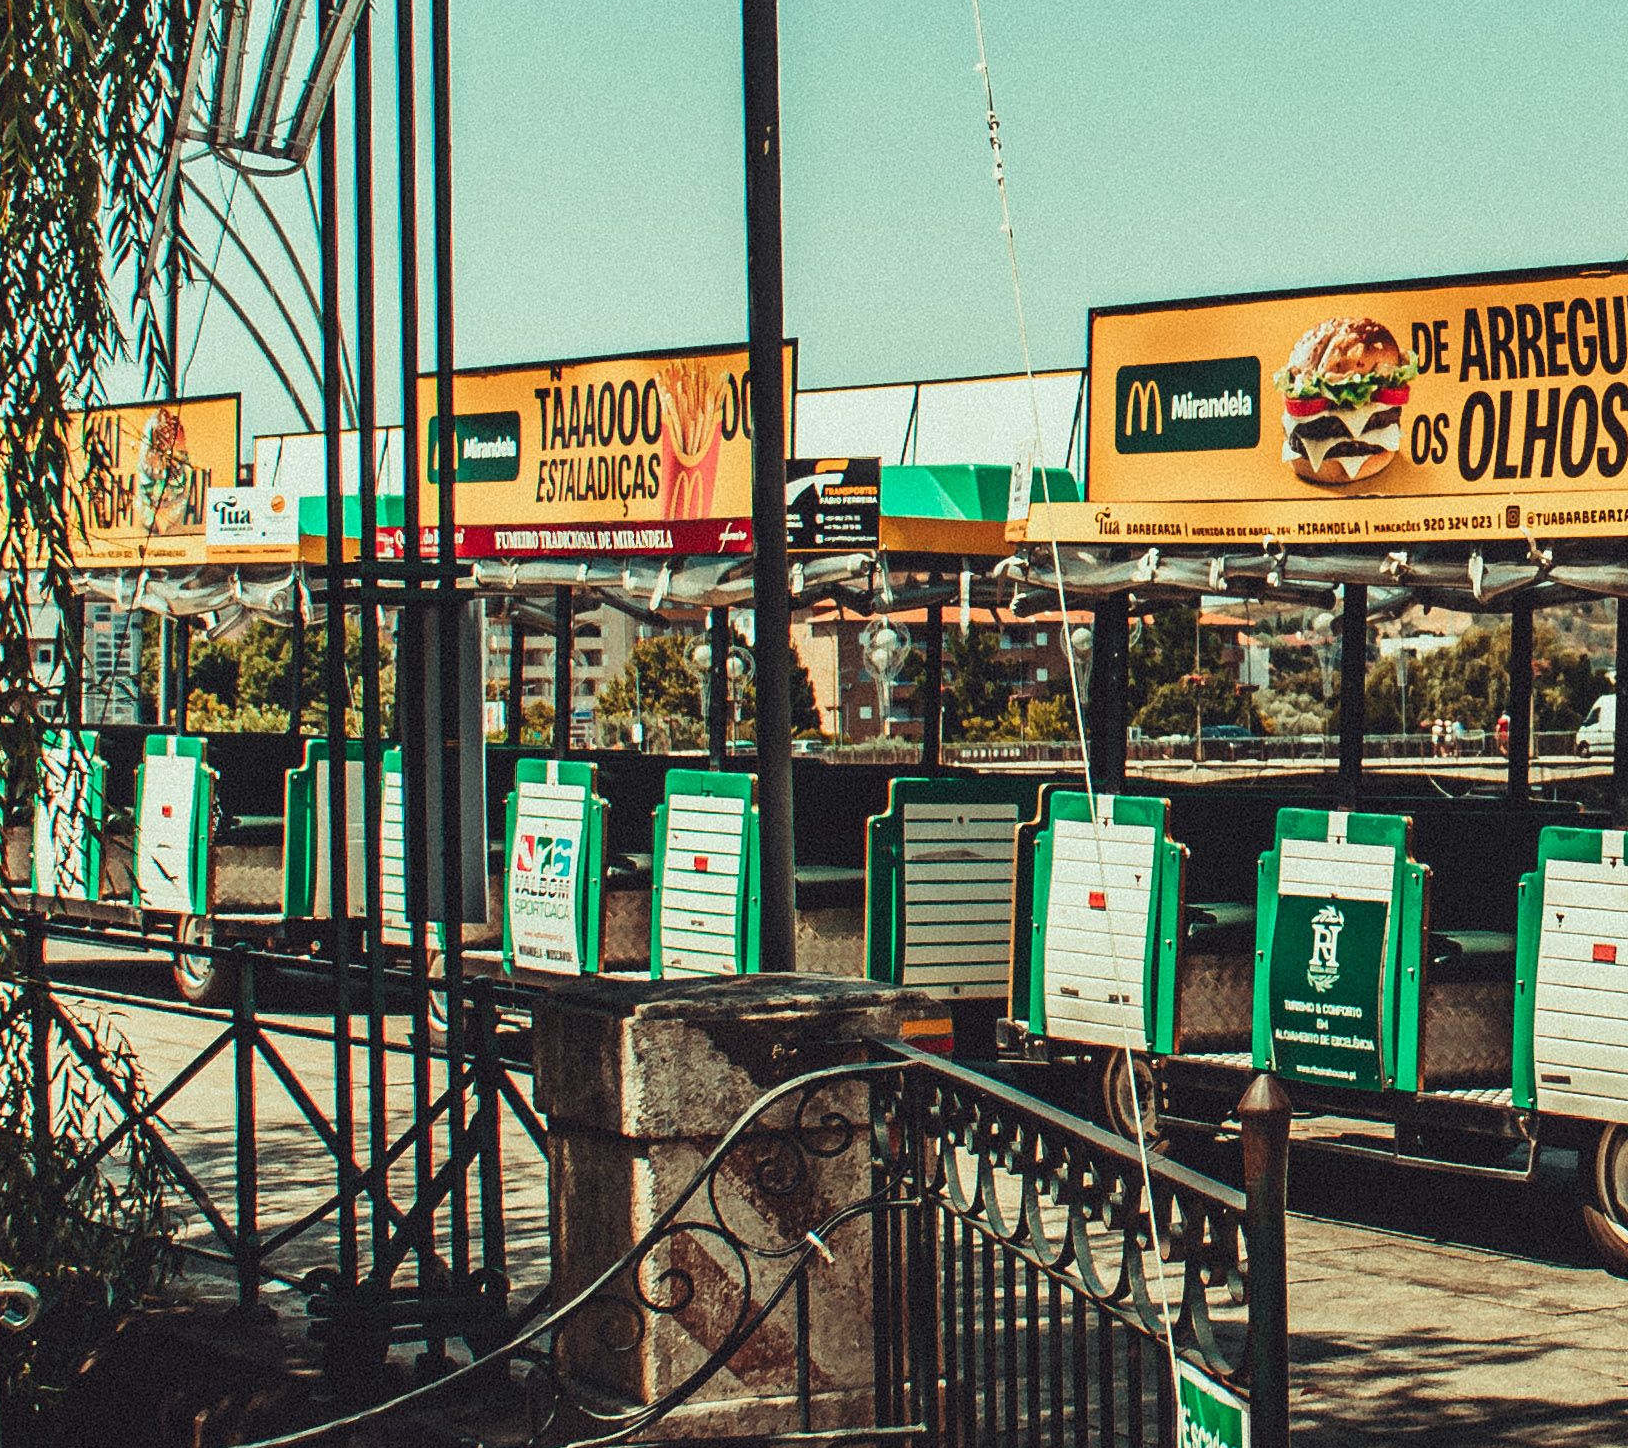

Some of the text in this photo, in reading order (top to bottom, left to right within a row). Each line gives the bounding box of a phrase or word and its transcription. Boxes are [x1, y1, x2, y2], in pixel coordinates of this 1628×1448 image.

[1413, 320, 1450, 375] DE
[1171, 390, 1253, 421] Mirandela
[464, 435, 517, 460] Mirandela
[1411, 414, 1448, 465] OS
[536, 452, 662, 518] ESTALADIÇAS
[495, 526, 674, 550] FUMEIRO TRADICIONAL DE MIRANDELA
[1126, 522, 1182, 536] BARBEARIA
[1297, 521, 1361, 535] MIRANDELA
